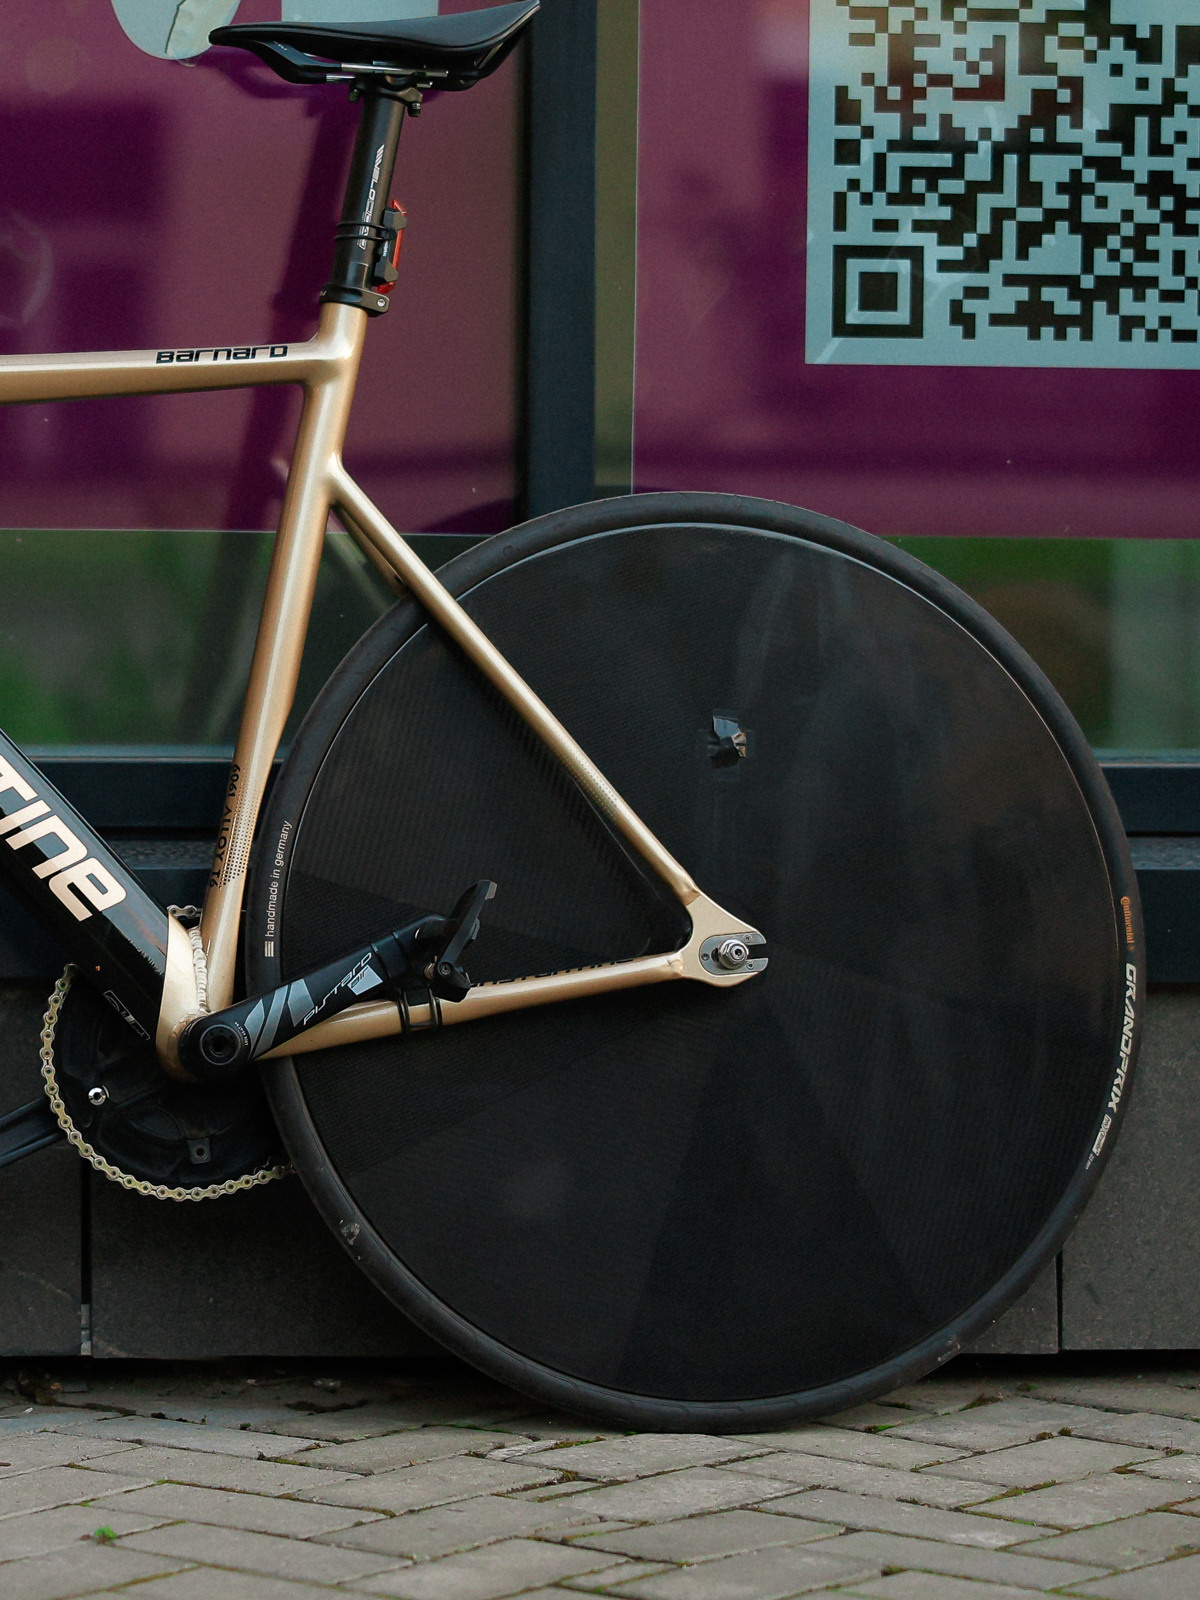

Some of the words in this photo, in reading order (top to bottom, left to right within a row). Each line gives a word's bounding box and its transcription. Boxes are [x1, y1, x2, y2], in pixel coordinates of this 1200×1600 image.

[228, 764, 240, 797] 6061
[215, 805, 232, 862] ALLOY
[274, 820, 294, 867] germany
[209, 869, 221, 888] T6
[273, 867, 281, 879] in
[265, 881, 279, 937] handmade
